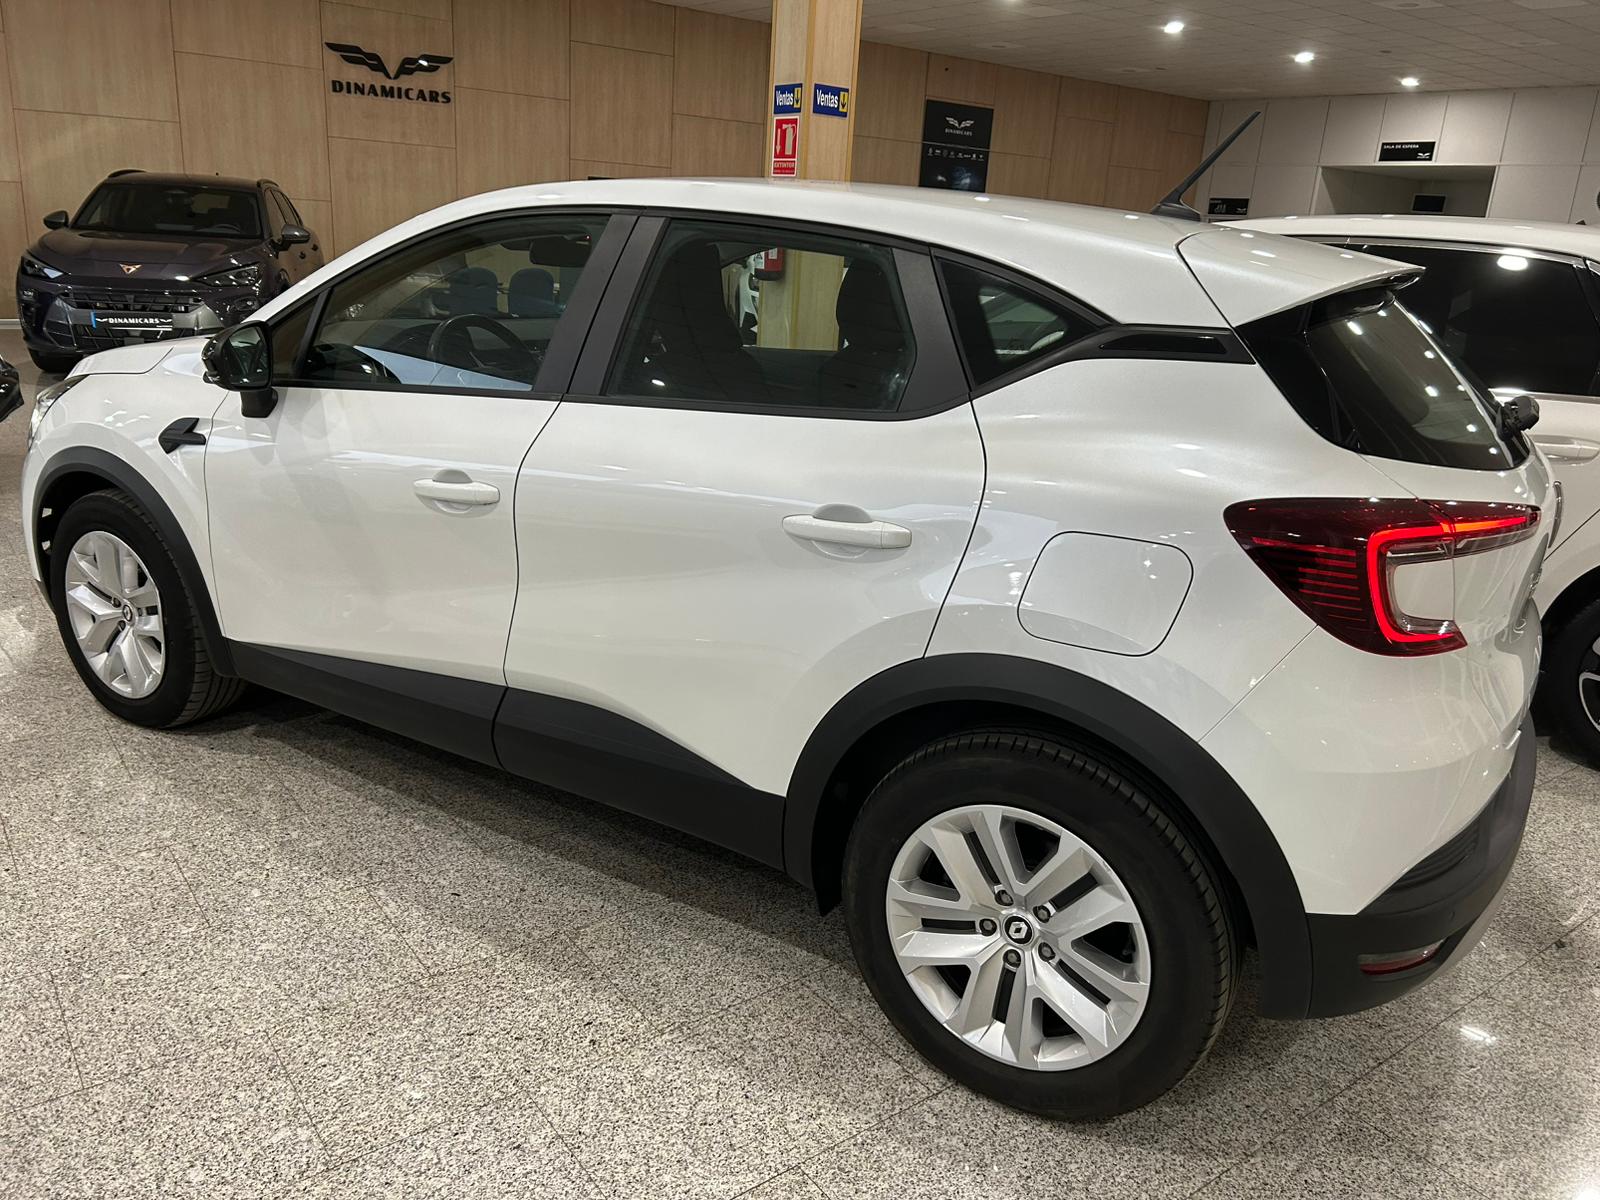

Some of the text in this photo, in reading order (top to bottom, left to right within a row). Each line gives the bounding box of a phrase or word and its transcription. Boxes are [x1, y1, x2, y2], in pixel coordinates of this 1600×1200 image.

[331, 79, 452, 104] DINAMICARS
[775, 90, 794, 106] Ventas
[816, 89, 839, 108] Ventas
